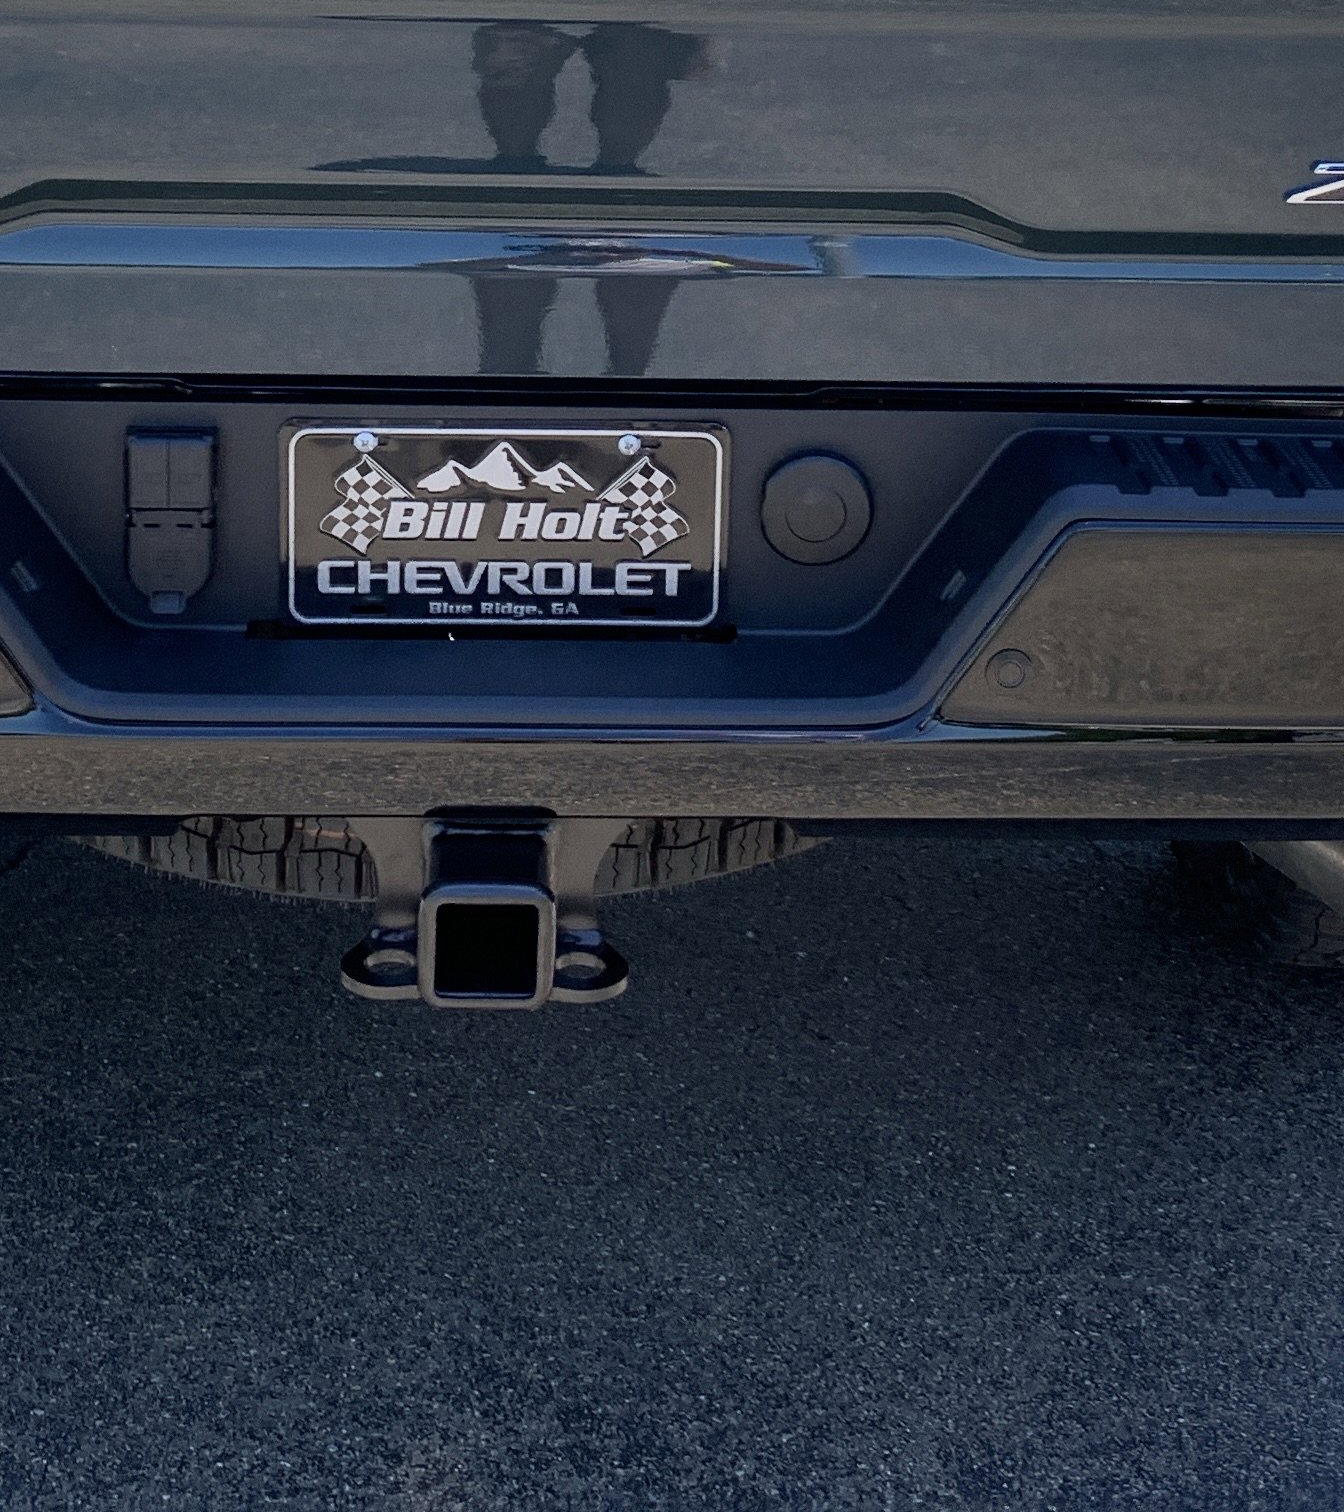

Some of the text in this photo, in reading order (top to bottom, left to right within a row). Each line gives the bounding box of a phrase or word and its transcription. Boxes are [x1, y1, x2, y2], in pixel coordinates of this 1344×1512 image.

[382, 501, 631, 541] Bill Holt
[317, 560, 692, 597] CHEVROLET
[429, 601, 473, 615] Blue
[551, 601, 579, 615] GA
